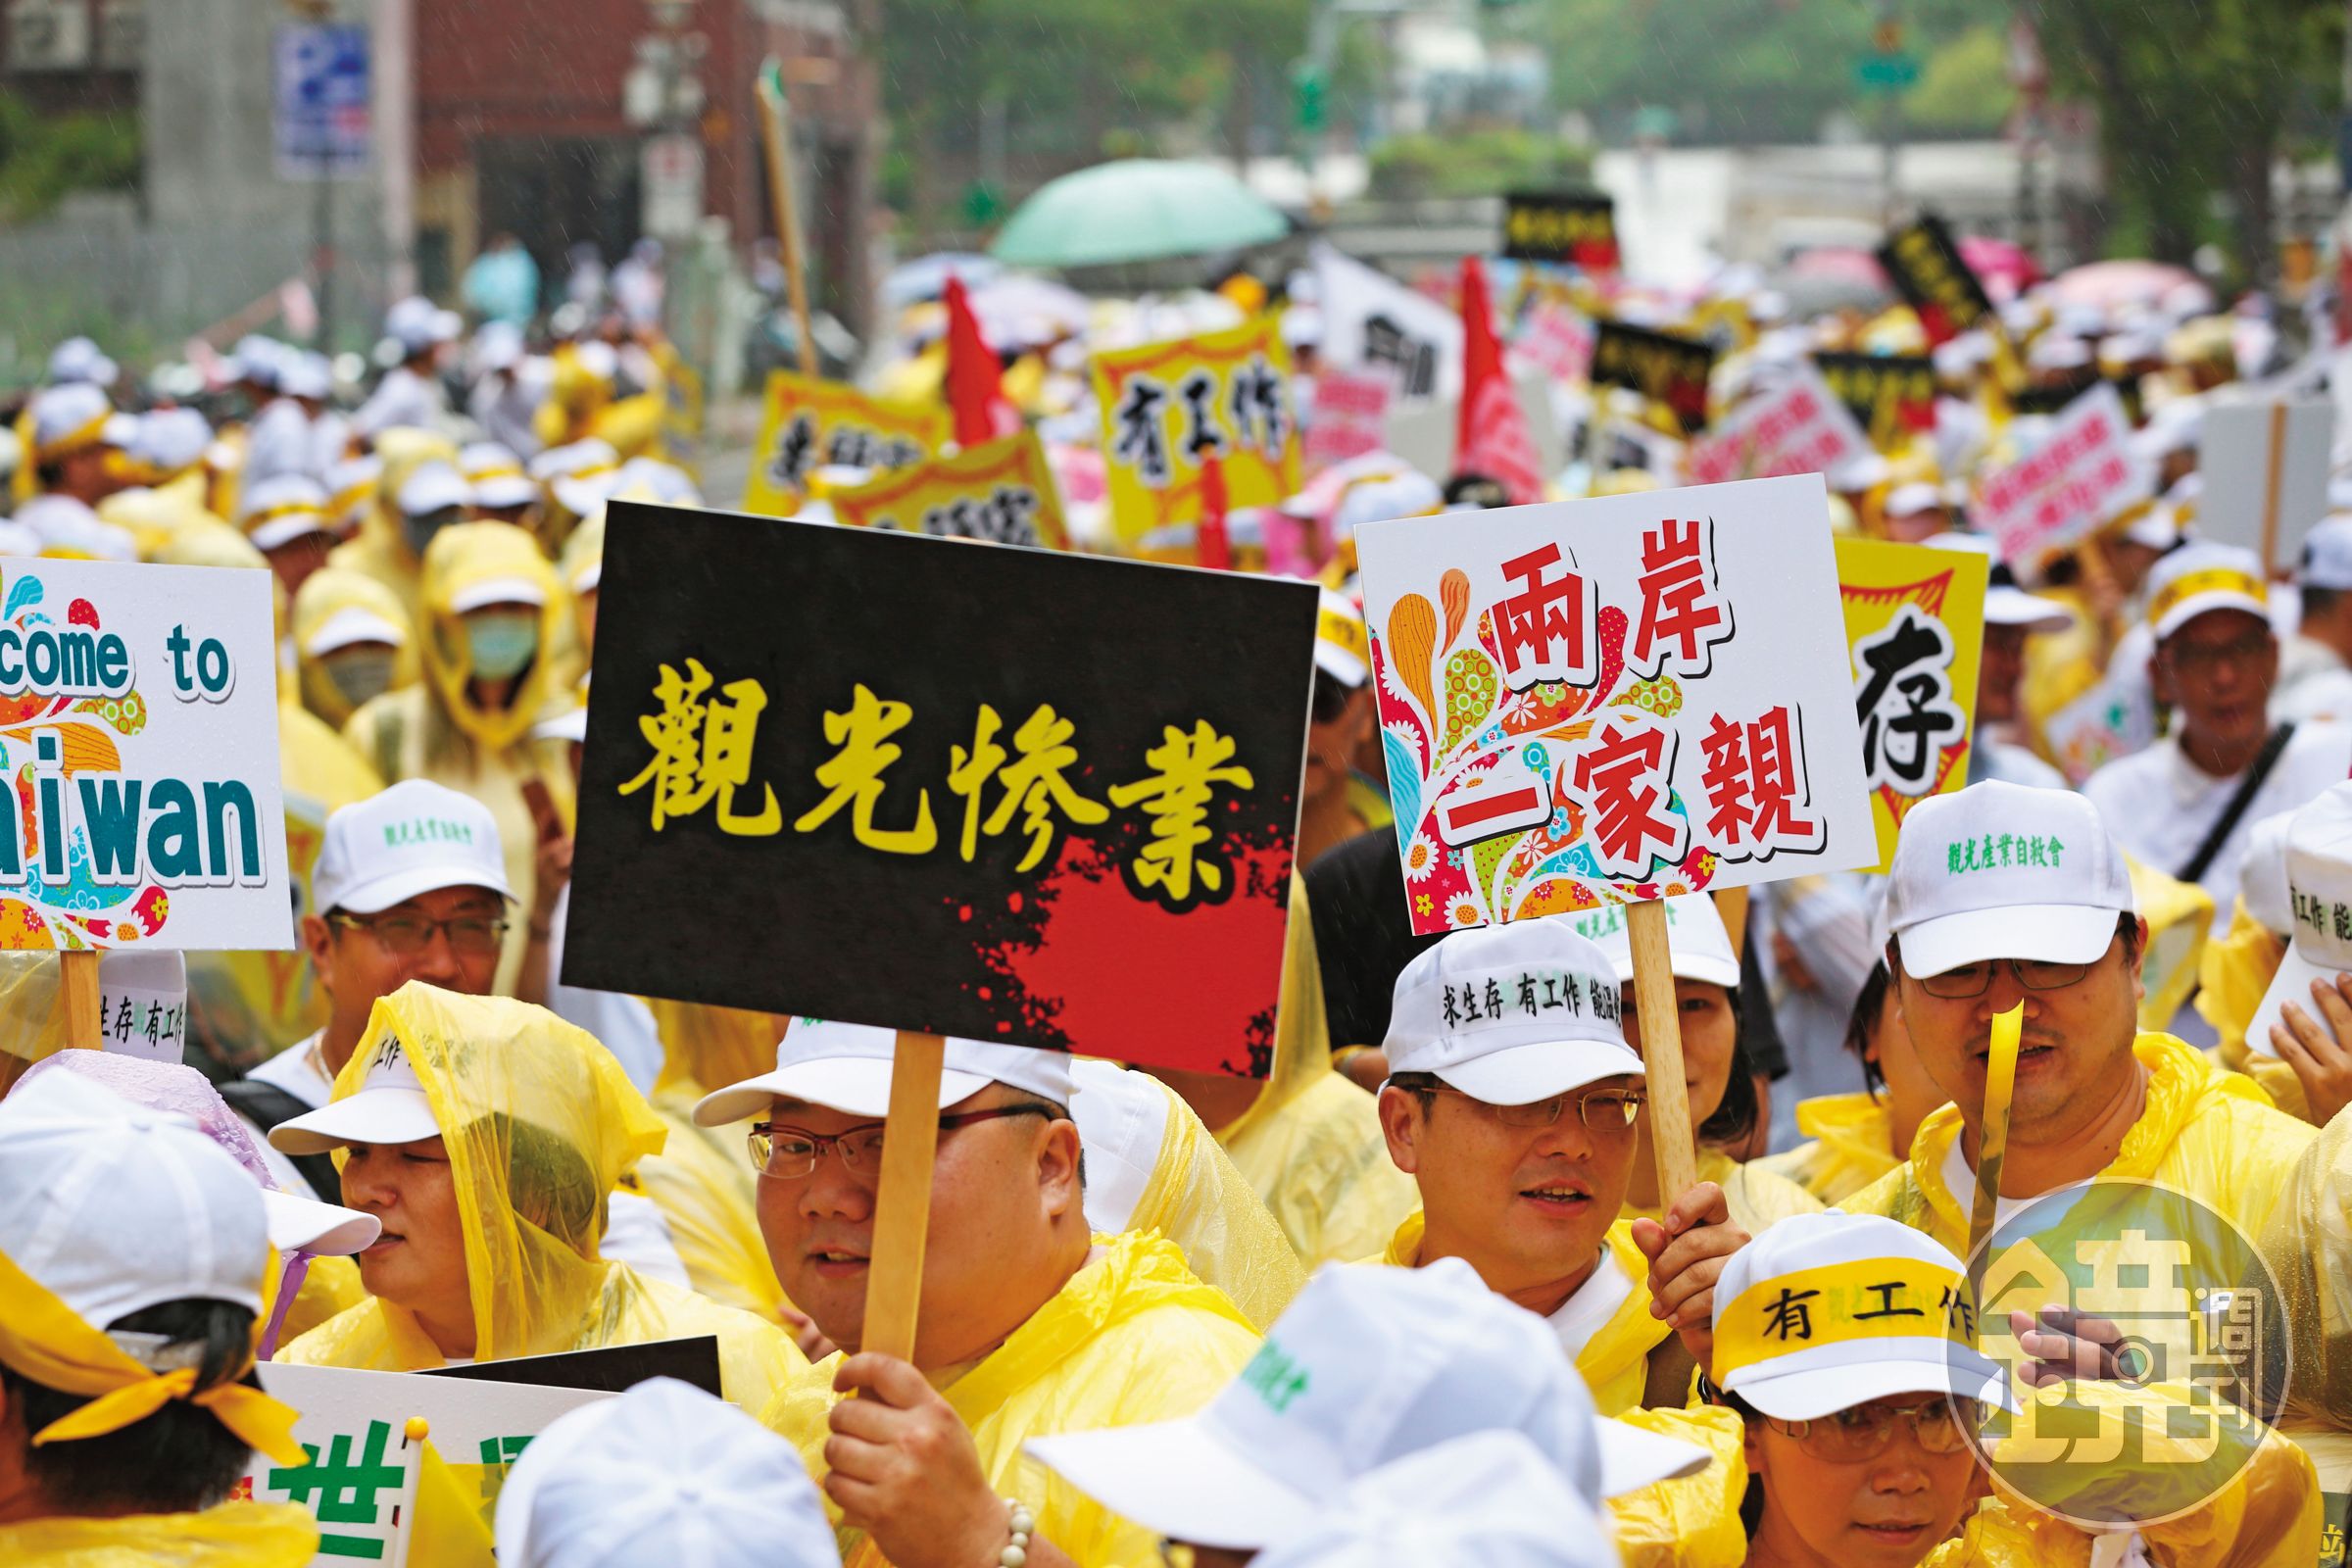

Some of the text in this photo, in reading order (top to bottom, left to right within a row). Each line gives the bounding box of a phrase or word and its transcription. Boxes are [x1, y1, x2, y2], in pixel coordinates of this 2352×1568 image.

[1493, 519, 1721, 674] 兩岸
[167, 624, 229, 692] to
[1856, 615, 1954, 781] 存
[617, 658, 1253, 901] 觀光慘業
[1447, 706, 1813, 863] 一家親
[1947, 833, 2065, 875] 觀光產業自救會
[1444, 976, 1503, 1029] 求生存
[1518, 972, 1582, 1017] 有工作
[1762, 1282, 1975, 1342] 有工作
